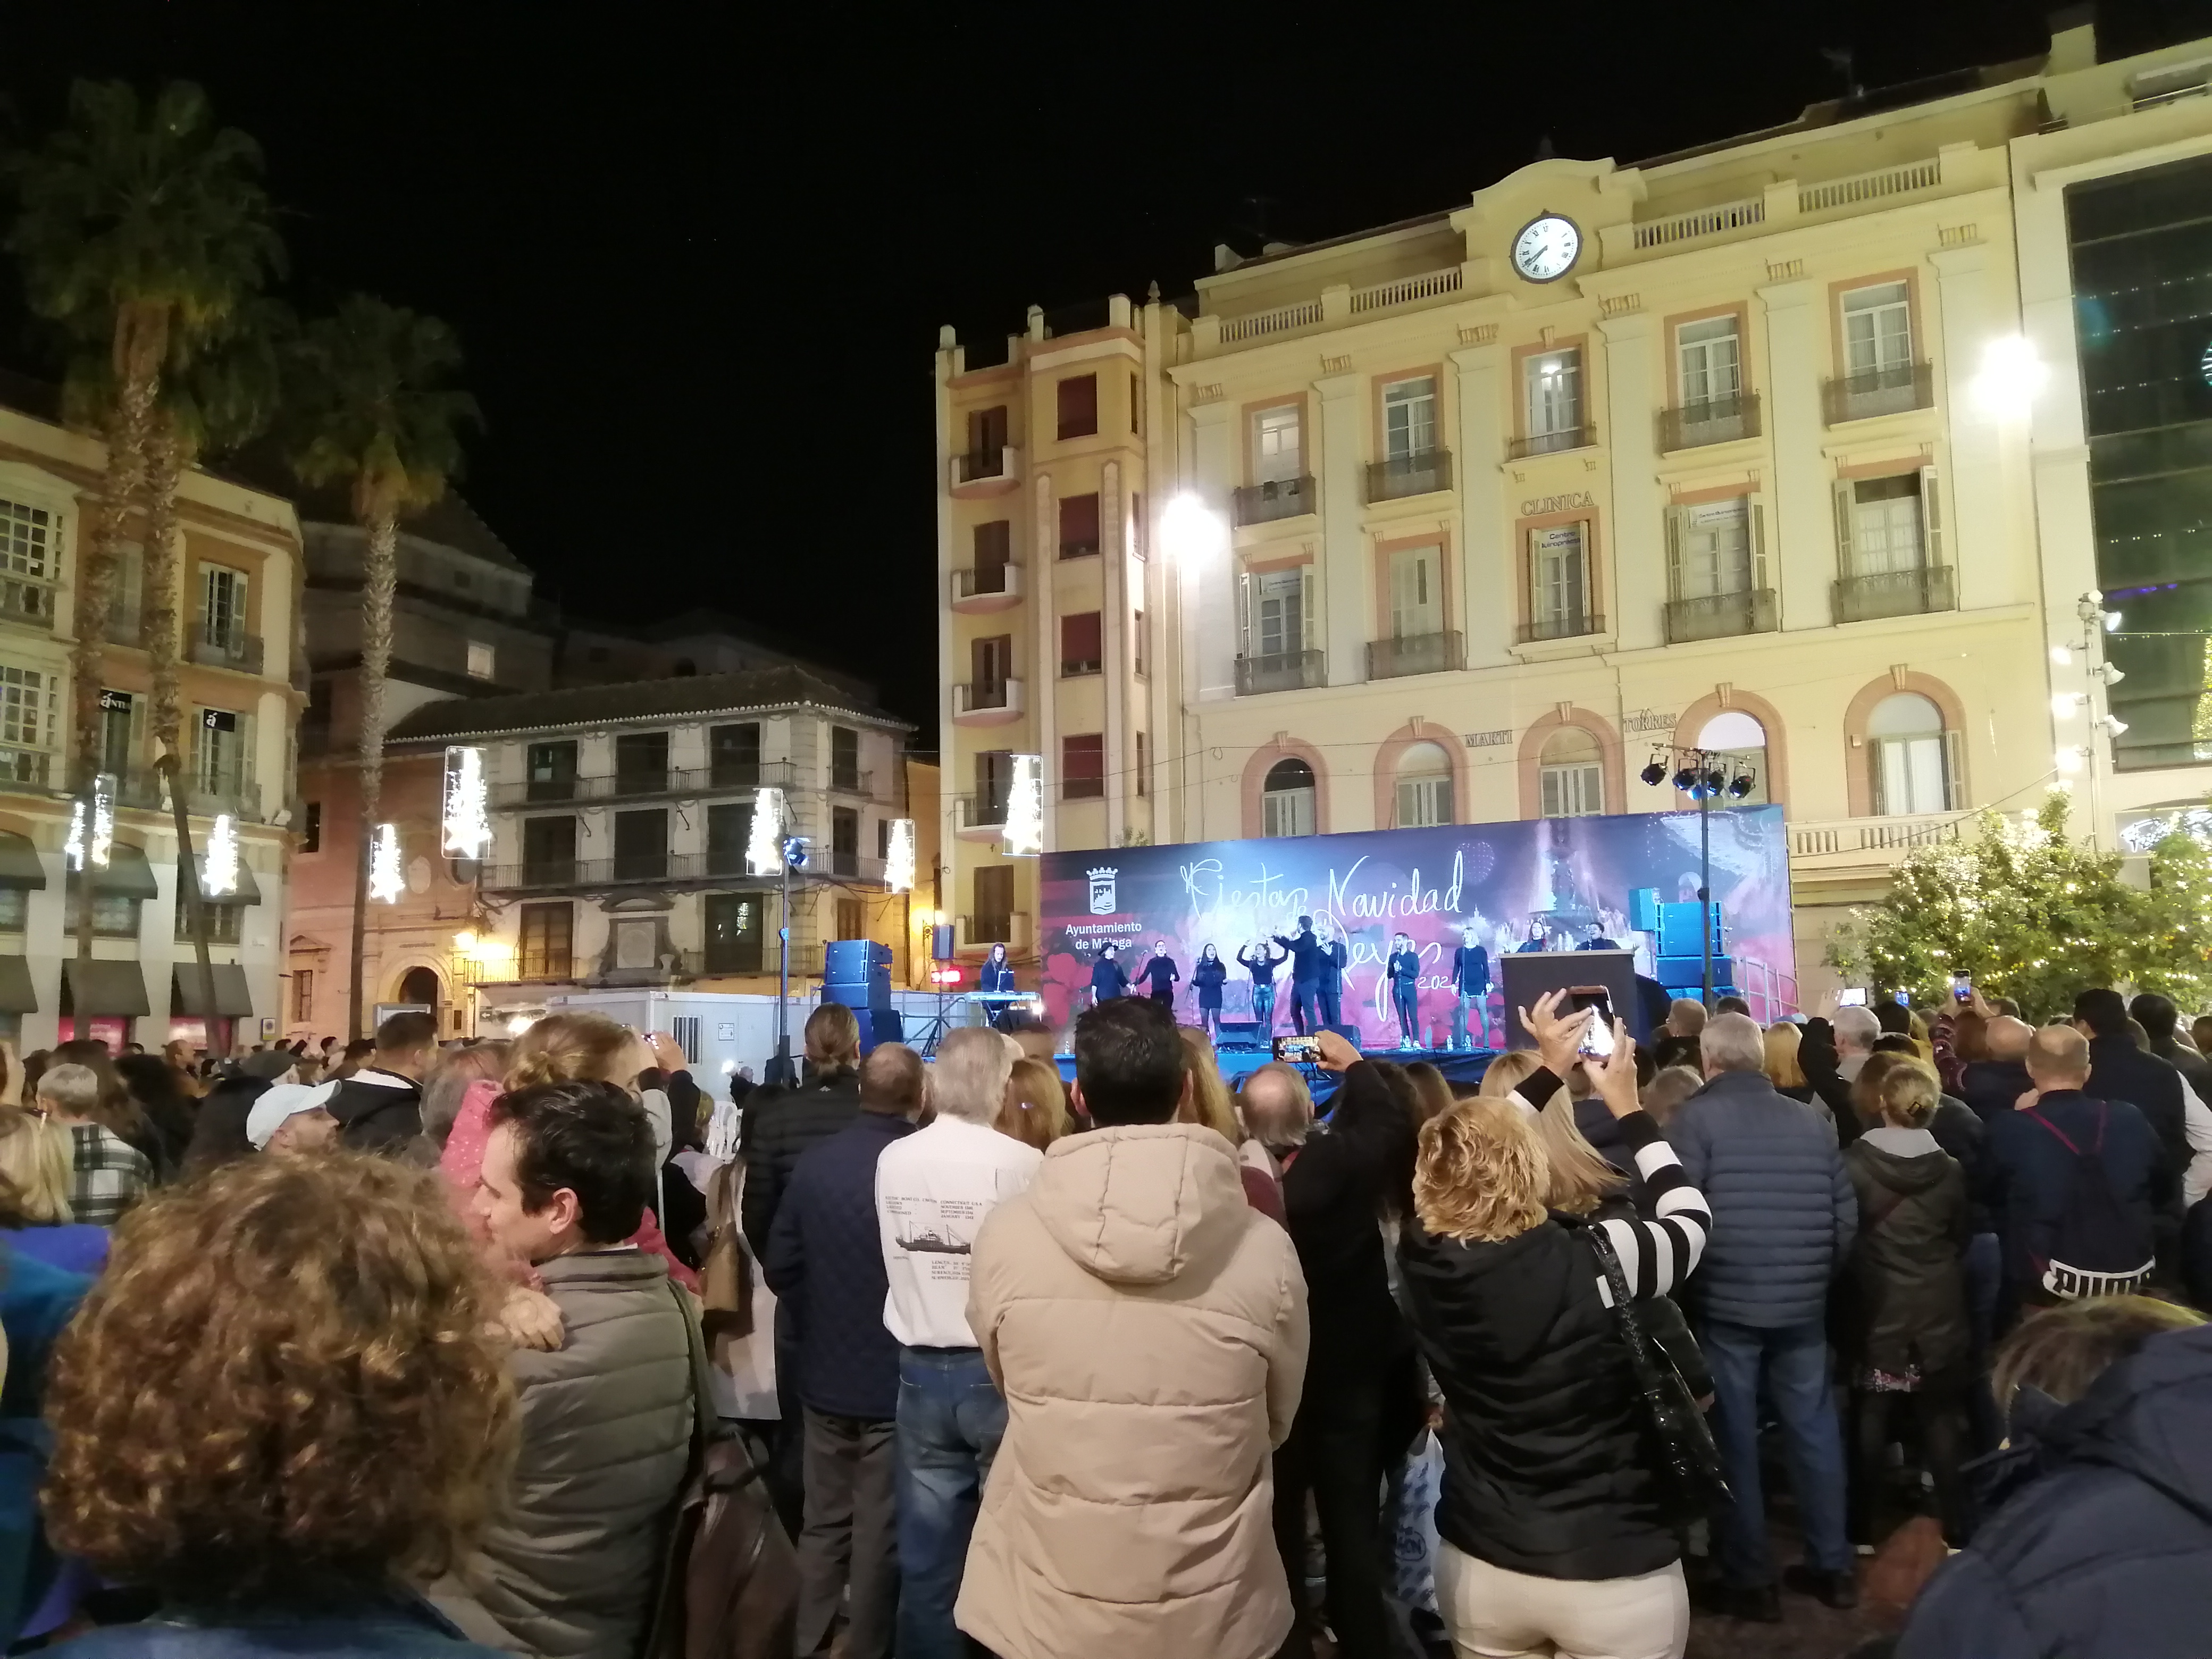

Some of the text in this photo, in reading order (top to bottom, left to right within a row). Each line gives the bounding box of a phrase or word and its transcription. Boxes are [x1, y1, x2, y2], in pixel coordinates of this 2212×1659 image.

[1521, 491, 1594, 516] CLINICA
[1623, 713, 1677, 733] TORRES
[1180, 858, 1308, 920] Fiestas
[1328, 850, 1463, 925] Navidad
[1065, 921, 1142, 937] Ayuntamiento
[1075, 939, 1089, 950] de
[1417, 975, 1459, 990] 202
